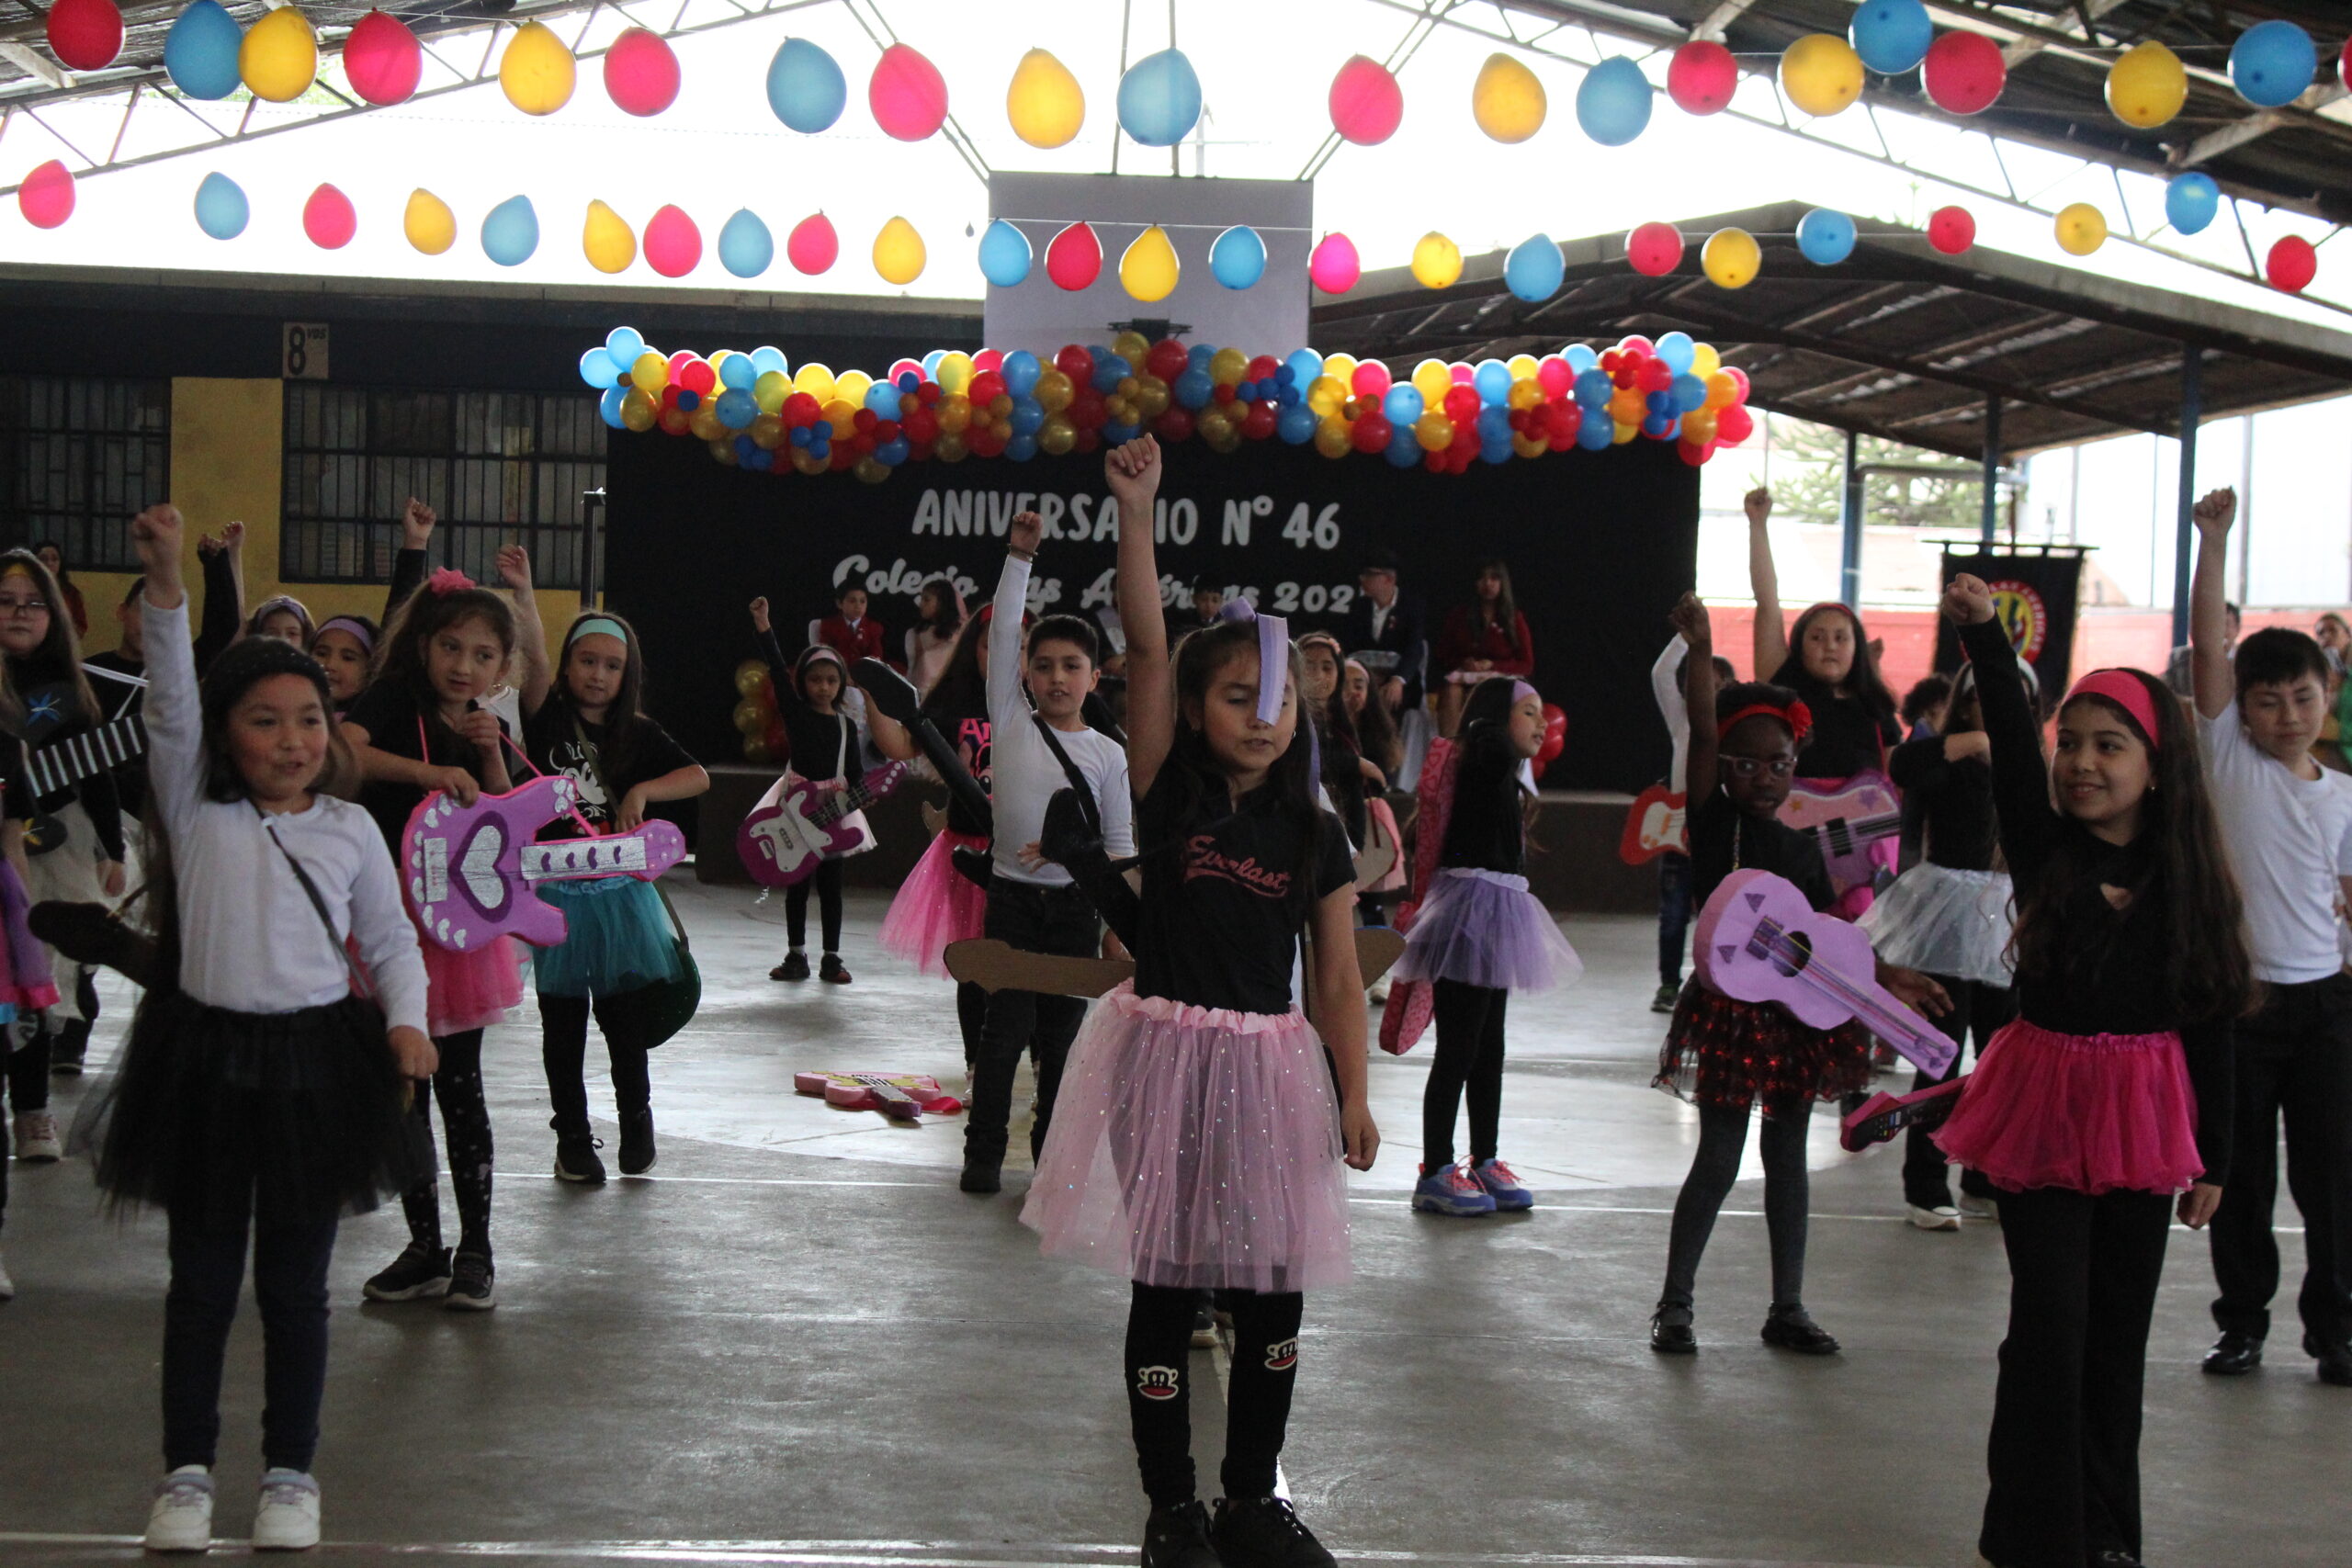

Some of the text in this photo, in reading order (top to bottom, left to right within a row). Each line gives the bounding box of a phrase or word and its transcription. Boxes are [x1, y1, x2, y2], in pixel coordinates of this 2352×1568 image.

[911, 488, 1199, 547] ANIVRSAIO
[1281, 501, 1340, 551] 46
[1272, 581, 1364, 615] 202
